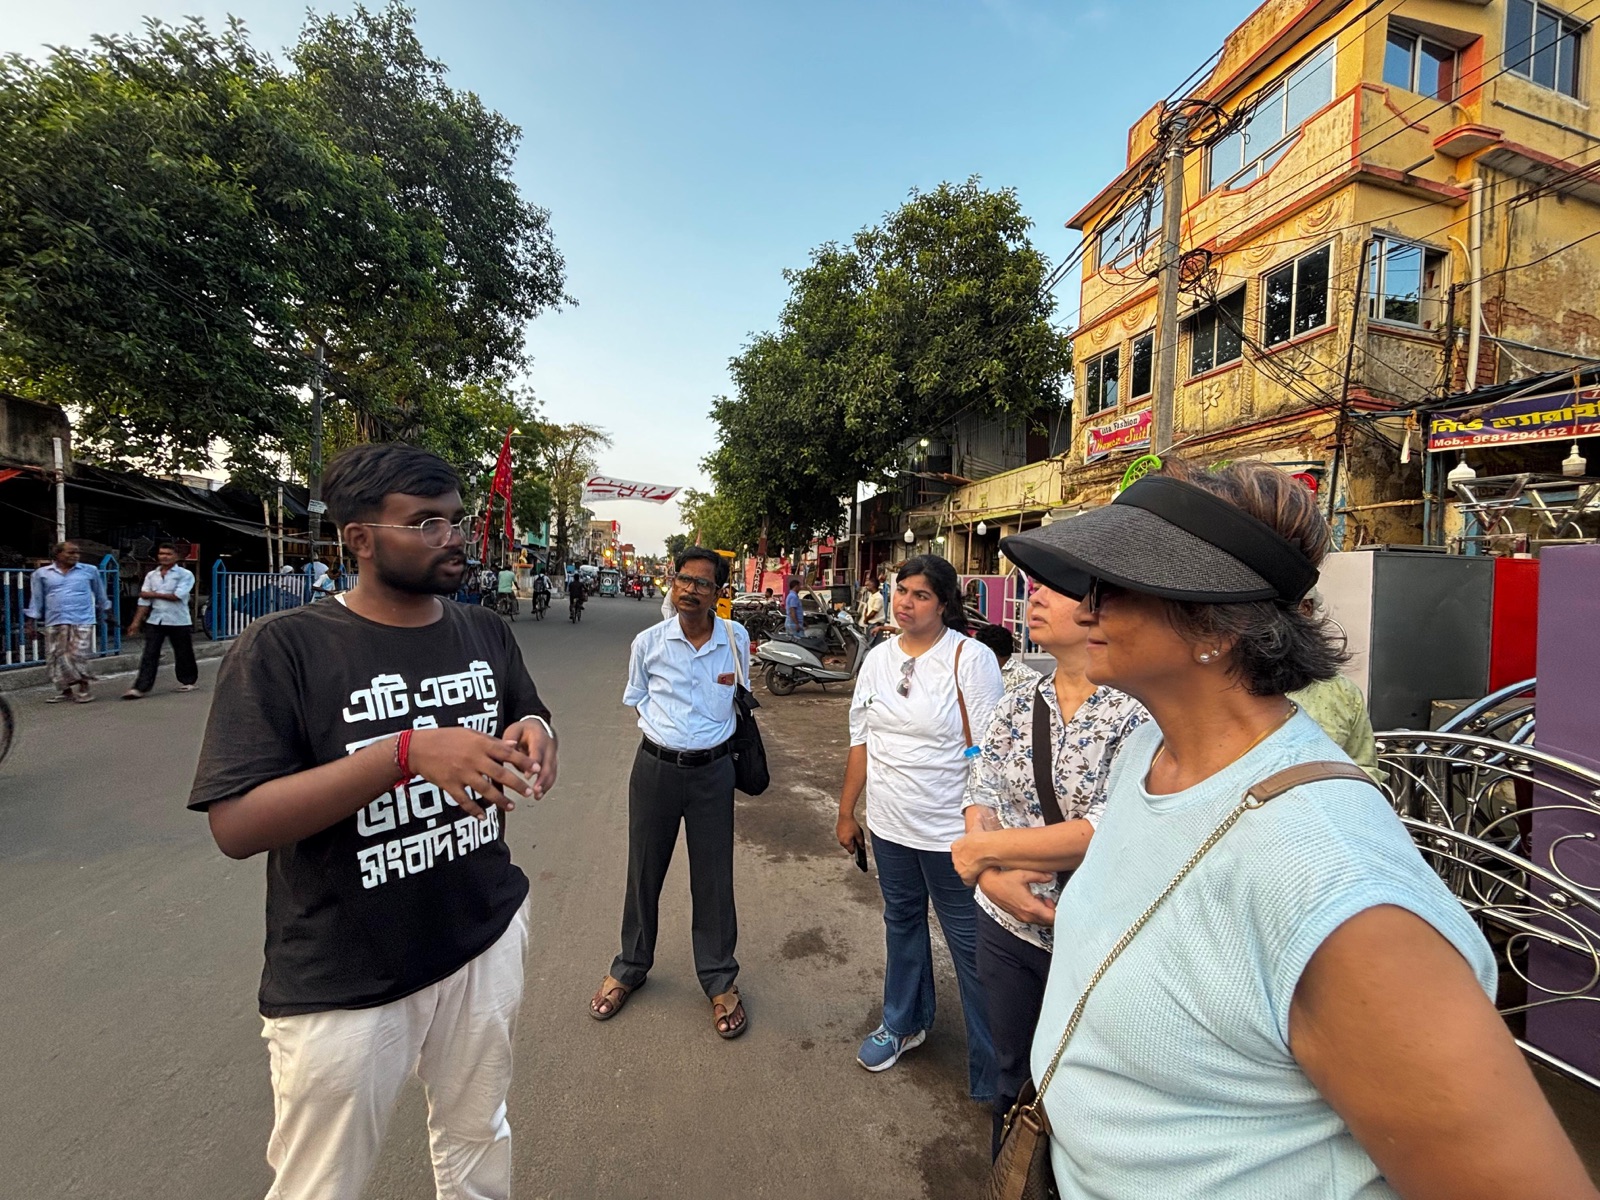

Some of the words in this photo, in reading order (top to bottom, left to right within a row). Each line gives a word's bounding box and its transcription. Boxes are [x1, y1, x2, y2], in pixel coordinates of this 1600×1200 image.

[1113, 418, 1138, 430] Fashion
[342, 673, 410, 723] এটি
[414, 660, 497, 709] একটি
[357, 823, 455, 890] সংবাদ
